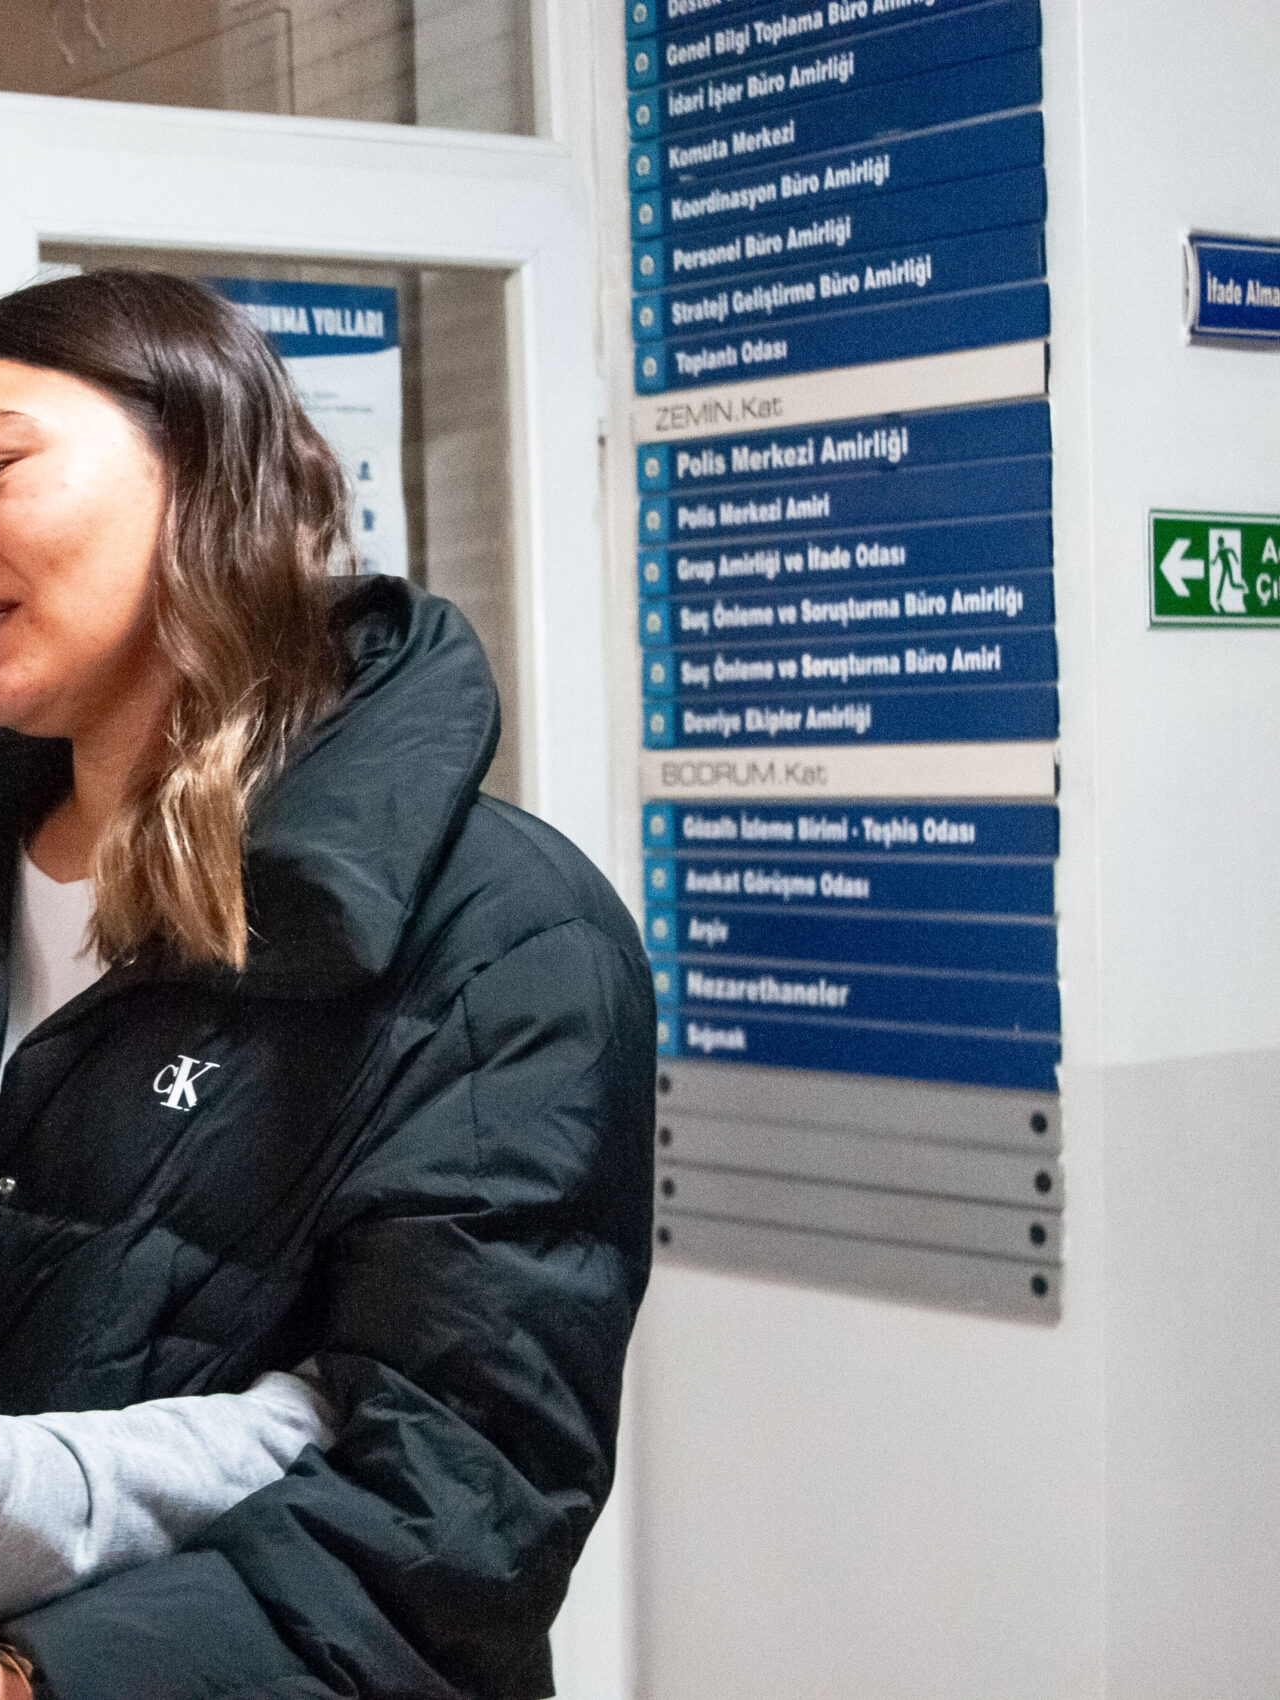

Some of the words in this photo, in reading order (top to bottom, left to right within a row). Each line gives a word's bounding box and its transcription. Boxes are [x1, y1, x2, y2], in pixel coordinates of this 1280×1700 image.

[666, 37, 710, 65] Genel
[715, 26, 749, 54] Bilgi
[754, 13, 822, 44] Toplama
[828, 0, 867, 24] Büro
[668, 89, 704, 116] İdari
[708, 82, 742, 111] İşler
[747, 74, 784, 97] Büro
[789, 52, 854, 88] Amirliği
[669, 141, 727, 168] Komuta
[732, 121, 794, 154] Merkezi
[672, 186, 775, 219] Koordinasyon
[780, 174, 818, 197] Büro
[824, 155, 889, 189] Amirliği
[673, 241, 740, 271] Personel
[745, 234, 782, 257] Büro
[787, 218, 850, 251] Amirliği
[672, 295, 728, 324] Strateji
[732, 282, 814, 314] Geliştirme
[820, 274, 858, 297] Büro
[864, 256, 931, 289] Amirliği
[312, 309, 383, 337] YOLLARI
[676, 348, 736, 376] Toplantı
[741, 340, 786, 363] Odası
[677, 452, 724, 478] Polis
[731, 440, 813, 471] Merkezi
[821, 429, 907, 462] Amirliği
[678, 507, 715, 528] Polis
[720, 500, 781, 525] Merkezi
[786, 494, 829, 519] Amiri
[677, 559, 714, 583] Grup
[718, 553, 779, 579] Amirliği
[784, 555, 802, 572] ve
[808, 545, 850, 570] İfade
[855, 545, 905, 565] Odası
[680, 609, 708, 634] Suç
[713, 602, 773, 627] Önleme
[778, 607, 796, 624] ve
[801, 599, 899, 627] Soruşturma
[905, 592, 946, 616] Büro
[681, 662, 709, 688] Suç
[713, 654, 773, 681] Önleme
[778, 661, 796, 678] ve
[801, 654, 899, 682] Soruşturma
[905, 649, 946, 673] Büro
[951, 646, 1000, 672] Amiri
[683, 711, 740, 738] Devriye
[744, 708, 801, 737] Ekipler
[805, 705, 870, 734] Amirliği
[862, 817, 918, 849] Teşhis
[923, 819, 974, 843] Odası
[820, 874, 868, 898] Odası
[687, 973, 848, 1006] Nezarethaneler
